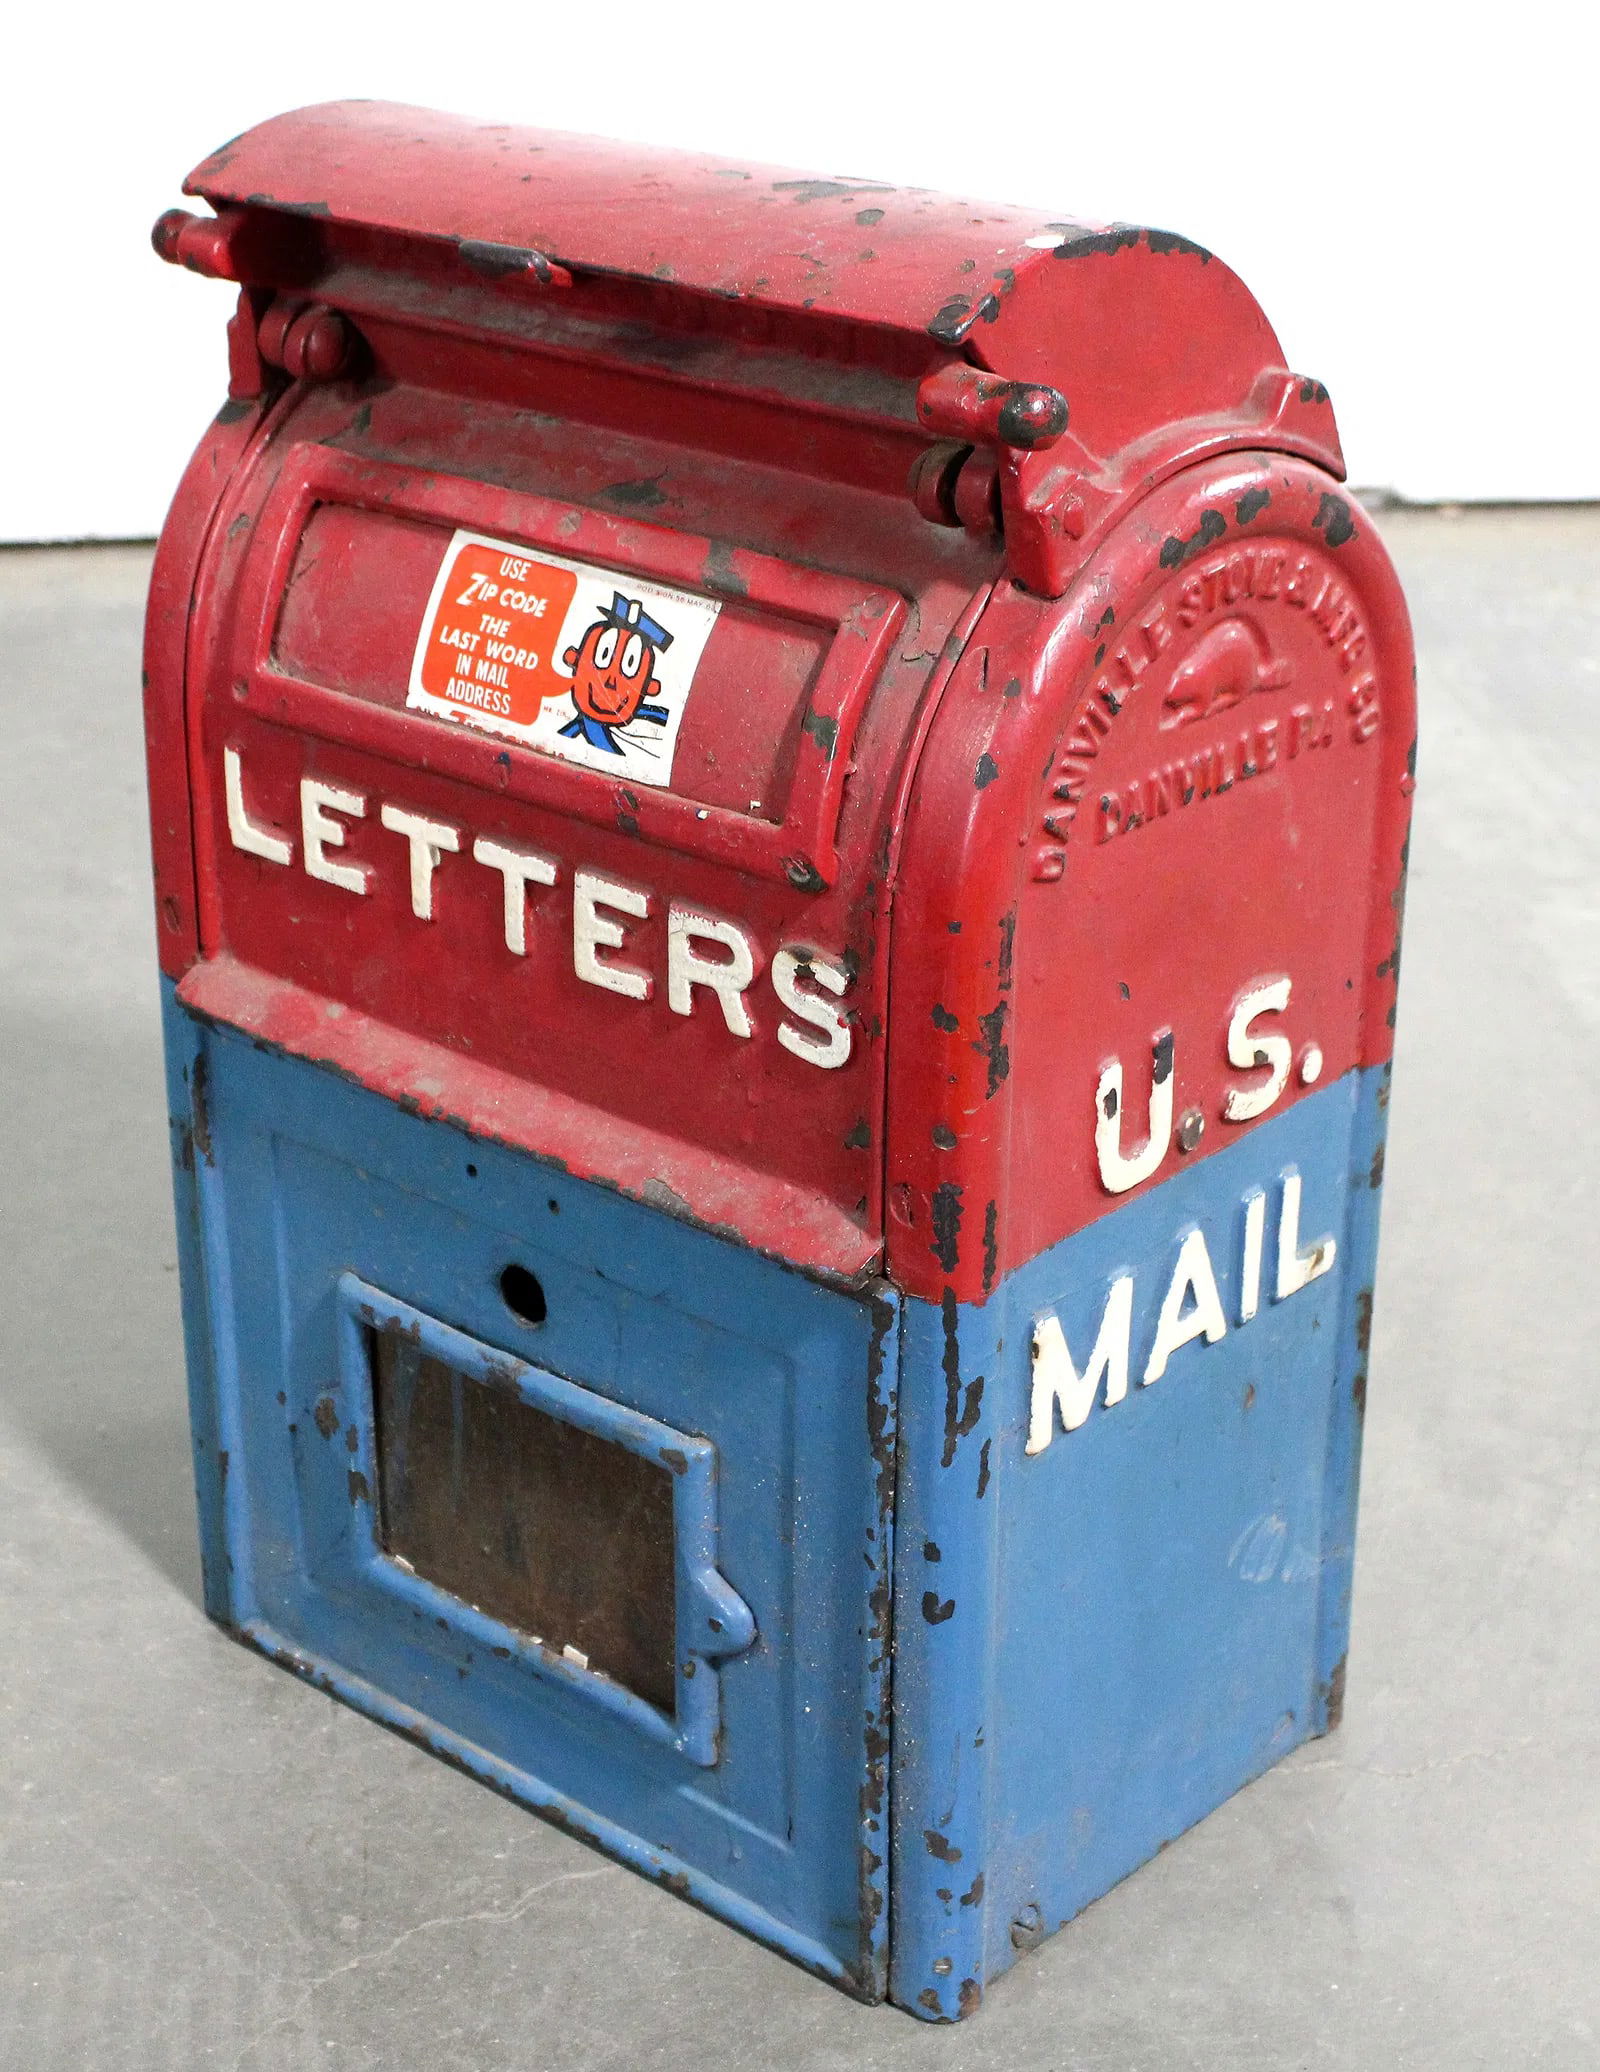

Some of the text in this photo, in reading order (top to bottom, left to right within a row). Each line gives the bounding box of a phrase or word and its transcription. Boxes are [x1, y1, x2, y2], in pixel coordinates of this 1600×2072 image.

[499, 557, 532, 582] USE
[499, 588, 549, 618] CODE
[440, 625, 539, 670] LAST WORD
[479, 614, 511, 638] THE
[455, 652, 509, 689] IN MAIL
[445, 676, 511, 714] ADDRESS
[1032, 600, 1174, 885] DANVILLE
[1176, 549, 1286, 629] STOVE
[1096, 718, 1280, 846] DANVILLE
[223, 745, 854, 1071] LETTERS
[1094, 974, 1324, 1194] U.S.
[1024, 1168, 1337, 1456] MAIL
